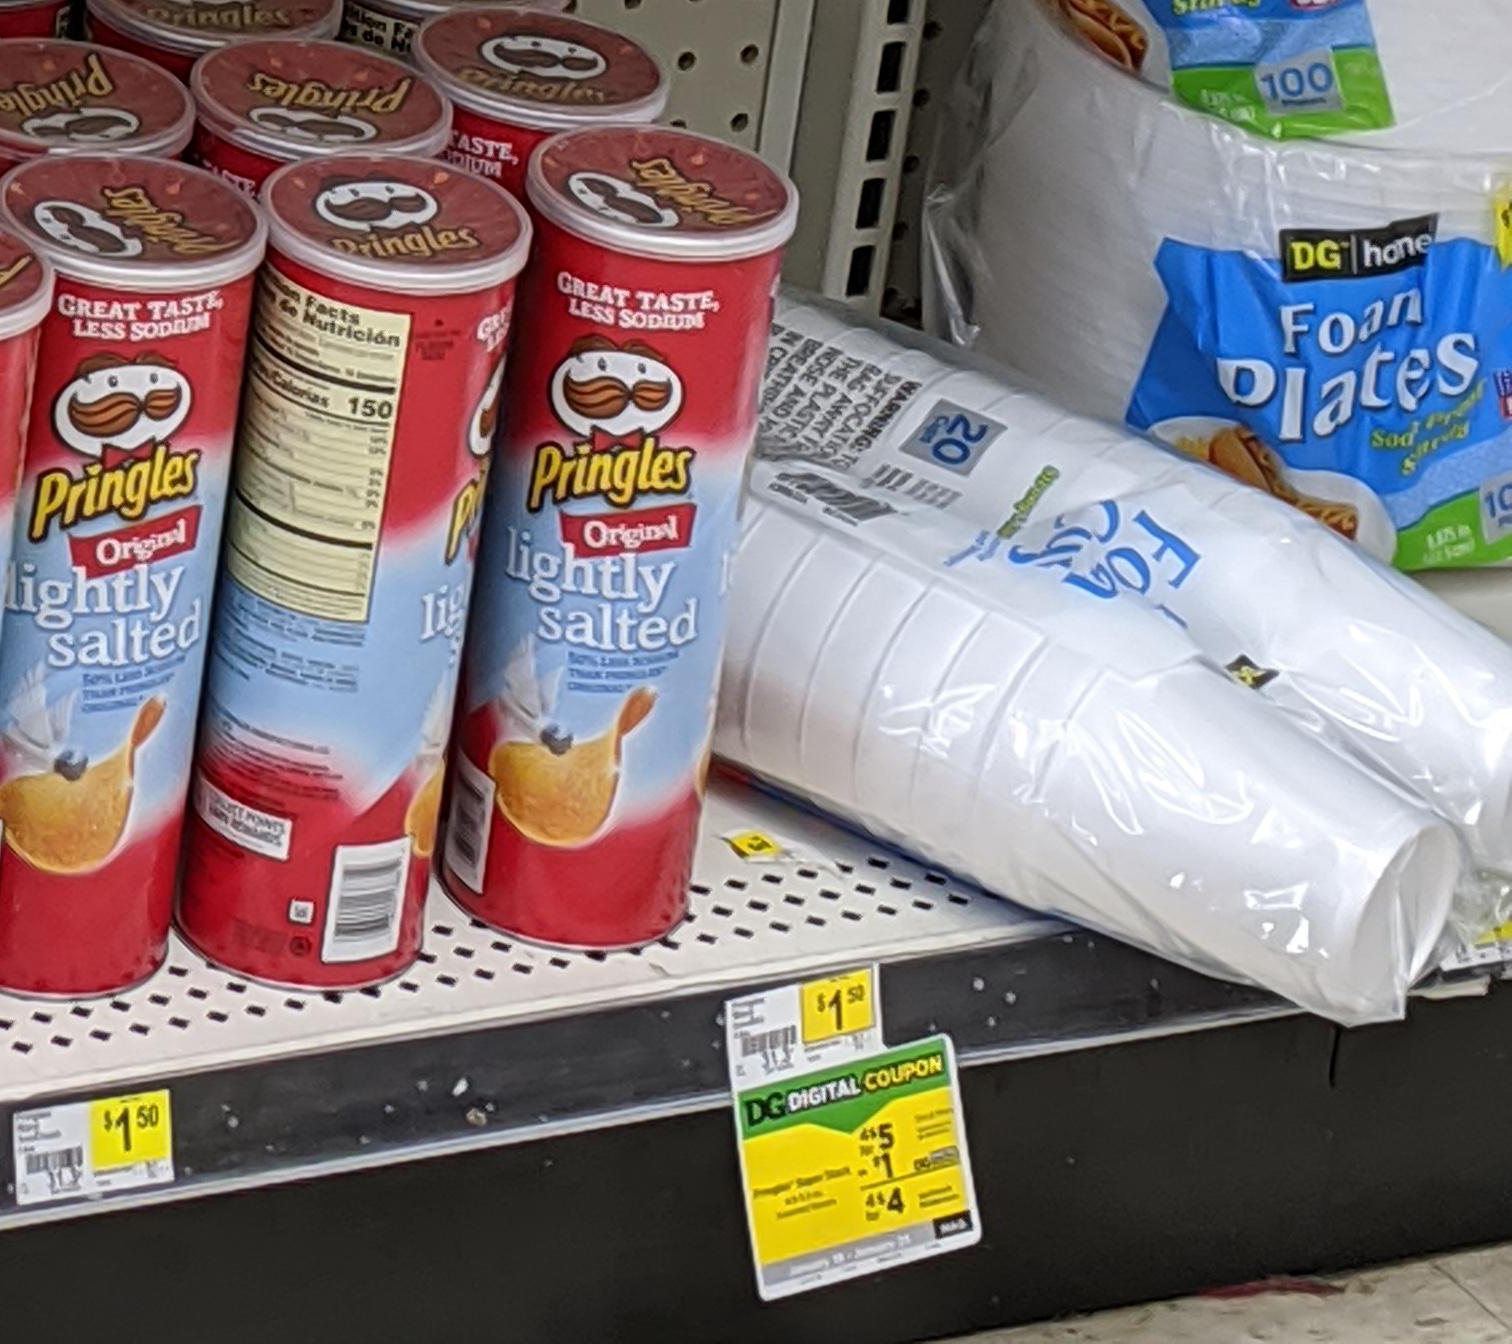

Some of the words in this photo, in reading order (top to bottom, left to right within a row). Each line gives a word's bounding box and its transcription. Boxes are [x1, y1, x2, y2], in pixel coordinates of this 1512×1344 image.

[248, 71, 417, 114] Pringles
[1261, 61, 1334, 101] 100
[332, 223, 481, 258] Pringles
[1291, 241, 1342, 272] DG
[1363, 232, 1433, 269] home
[57, 292, 147, 321] GREAT
[306, 292, 361, 327] Facts
[557, 272, 631, 309] GREAT
[73, 317, 127, 340] LESS
[130, 312, 212, 343] SODIUM
[303, 308, 403, 348] Nutrición
[569, 298, 616, 326] LESS
[618, 306, 707, 331] SODIUM
[348, 395, 394, 421] 150
[849, 380, 923, 452] WARNING:
[931, 412, 988, 466] 20
[30, 441, 199, 543] Pringles
[528, 434, 692, 513] Pringles
[95, 519, 187, 567] Original
[582, 514, 680, 550] Original
[506, 527, 676, 614] lightly
[5, 560, 186, 631] lightly
[47, 597, 202, 670] salted
[538, 597, 698, 654] salted
[746, 1094, 785, 1127] DG
[787, 1077, 862, 1112] DIGITAL
[864, 1055, 943, 1090] COUPON
